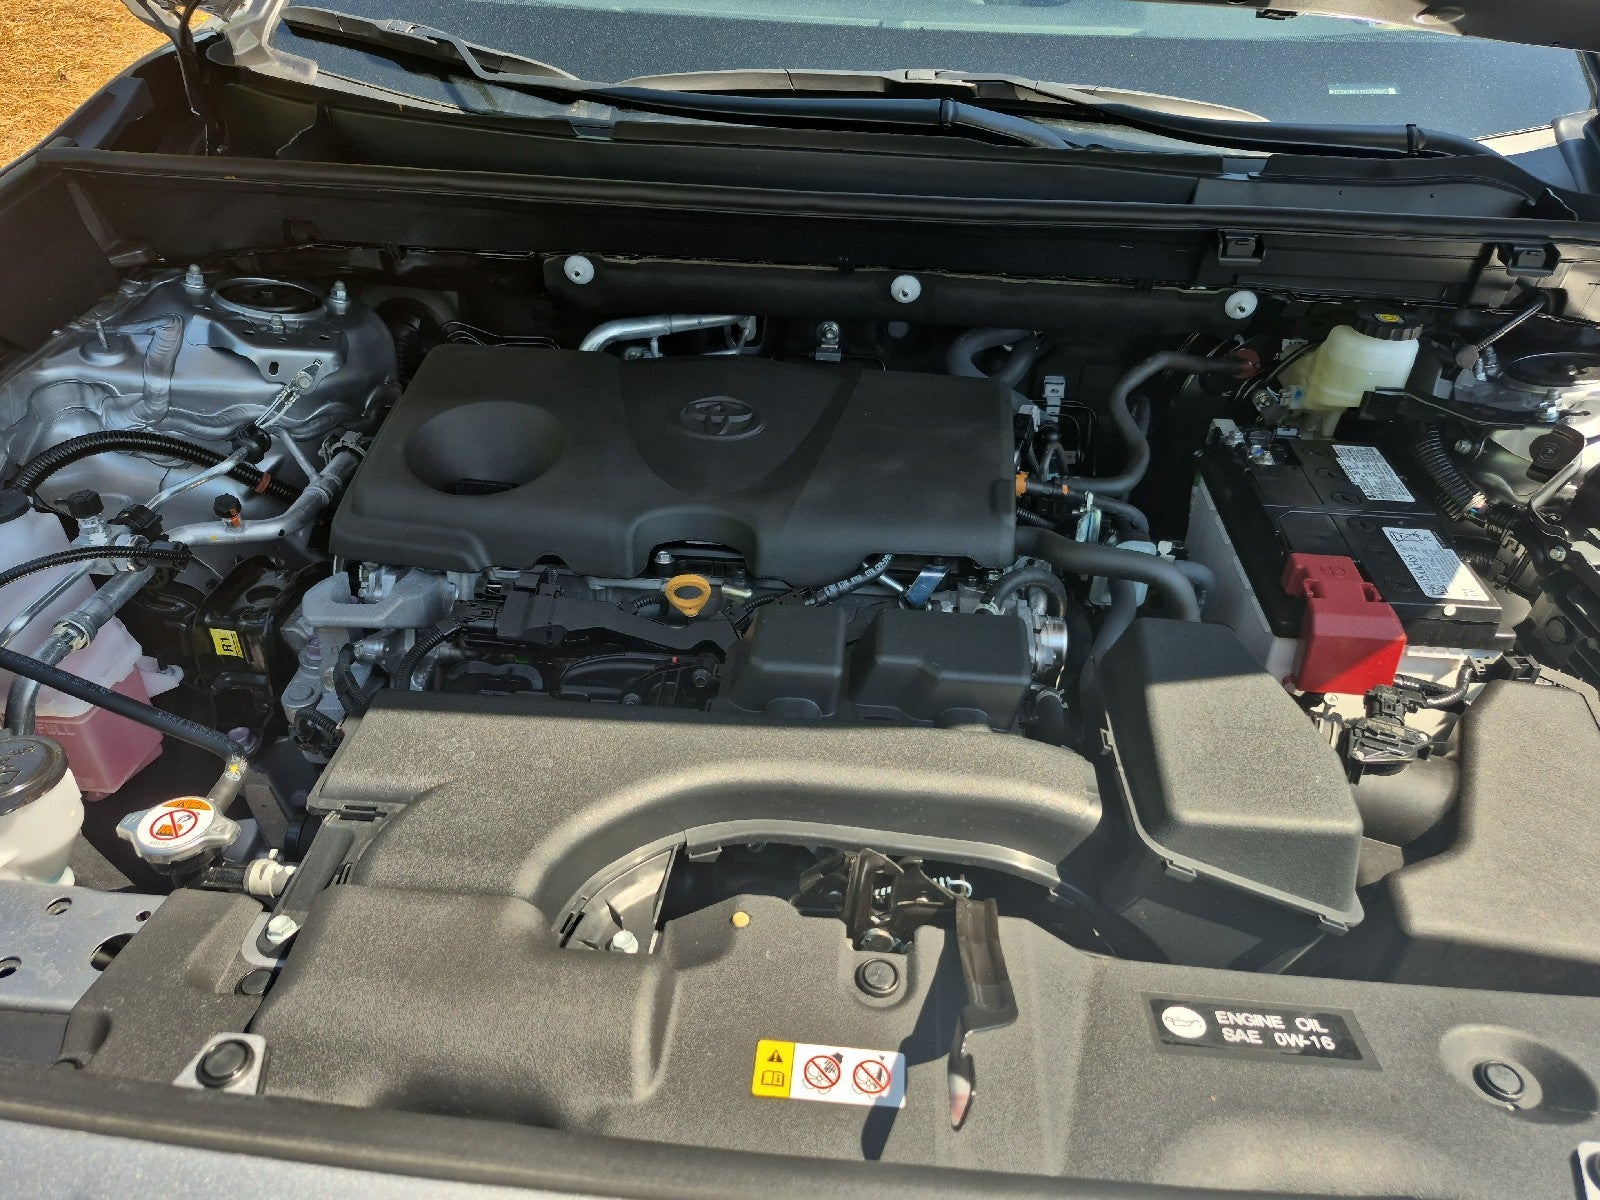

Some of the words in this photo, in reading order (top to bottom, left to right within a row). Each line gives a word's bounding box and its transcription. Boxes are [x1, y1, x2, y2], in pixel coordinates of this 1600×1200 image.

[37, 722, 76, 736] FULL
[1214, 1010, 1286, 1029] ENGINE
[1294, 1017, 1330, 1034] OIL
[1222, 1027, 1263, 1045] SAE
[1273, 1031, 1336, 1051] 0W-16
